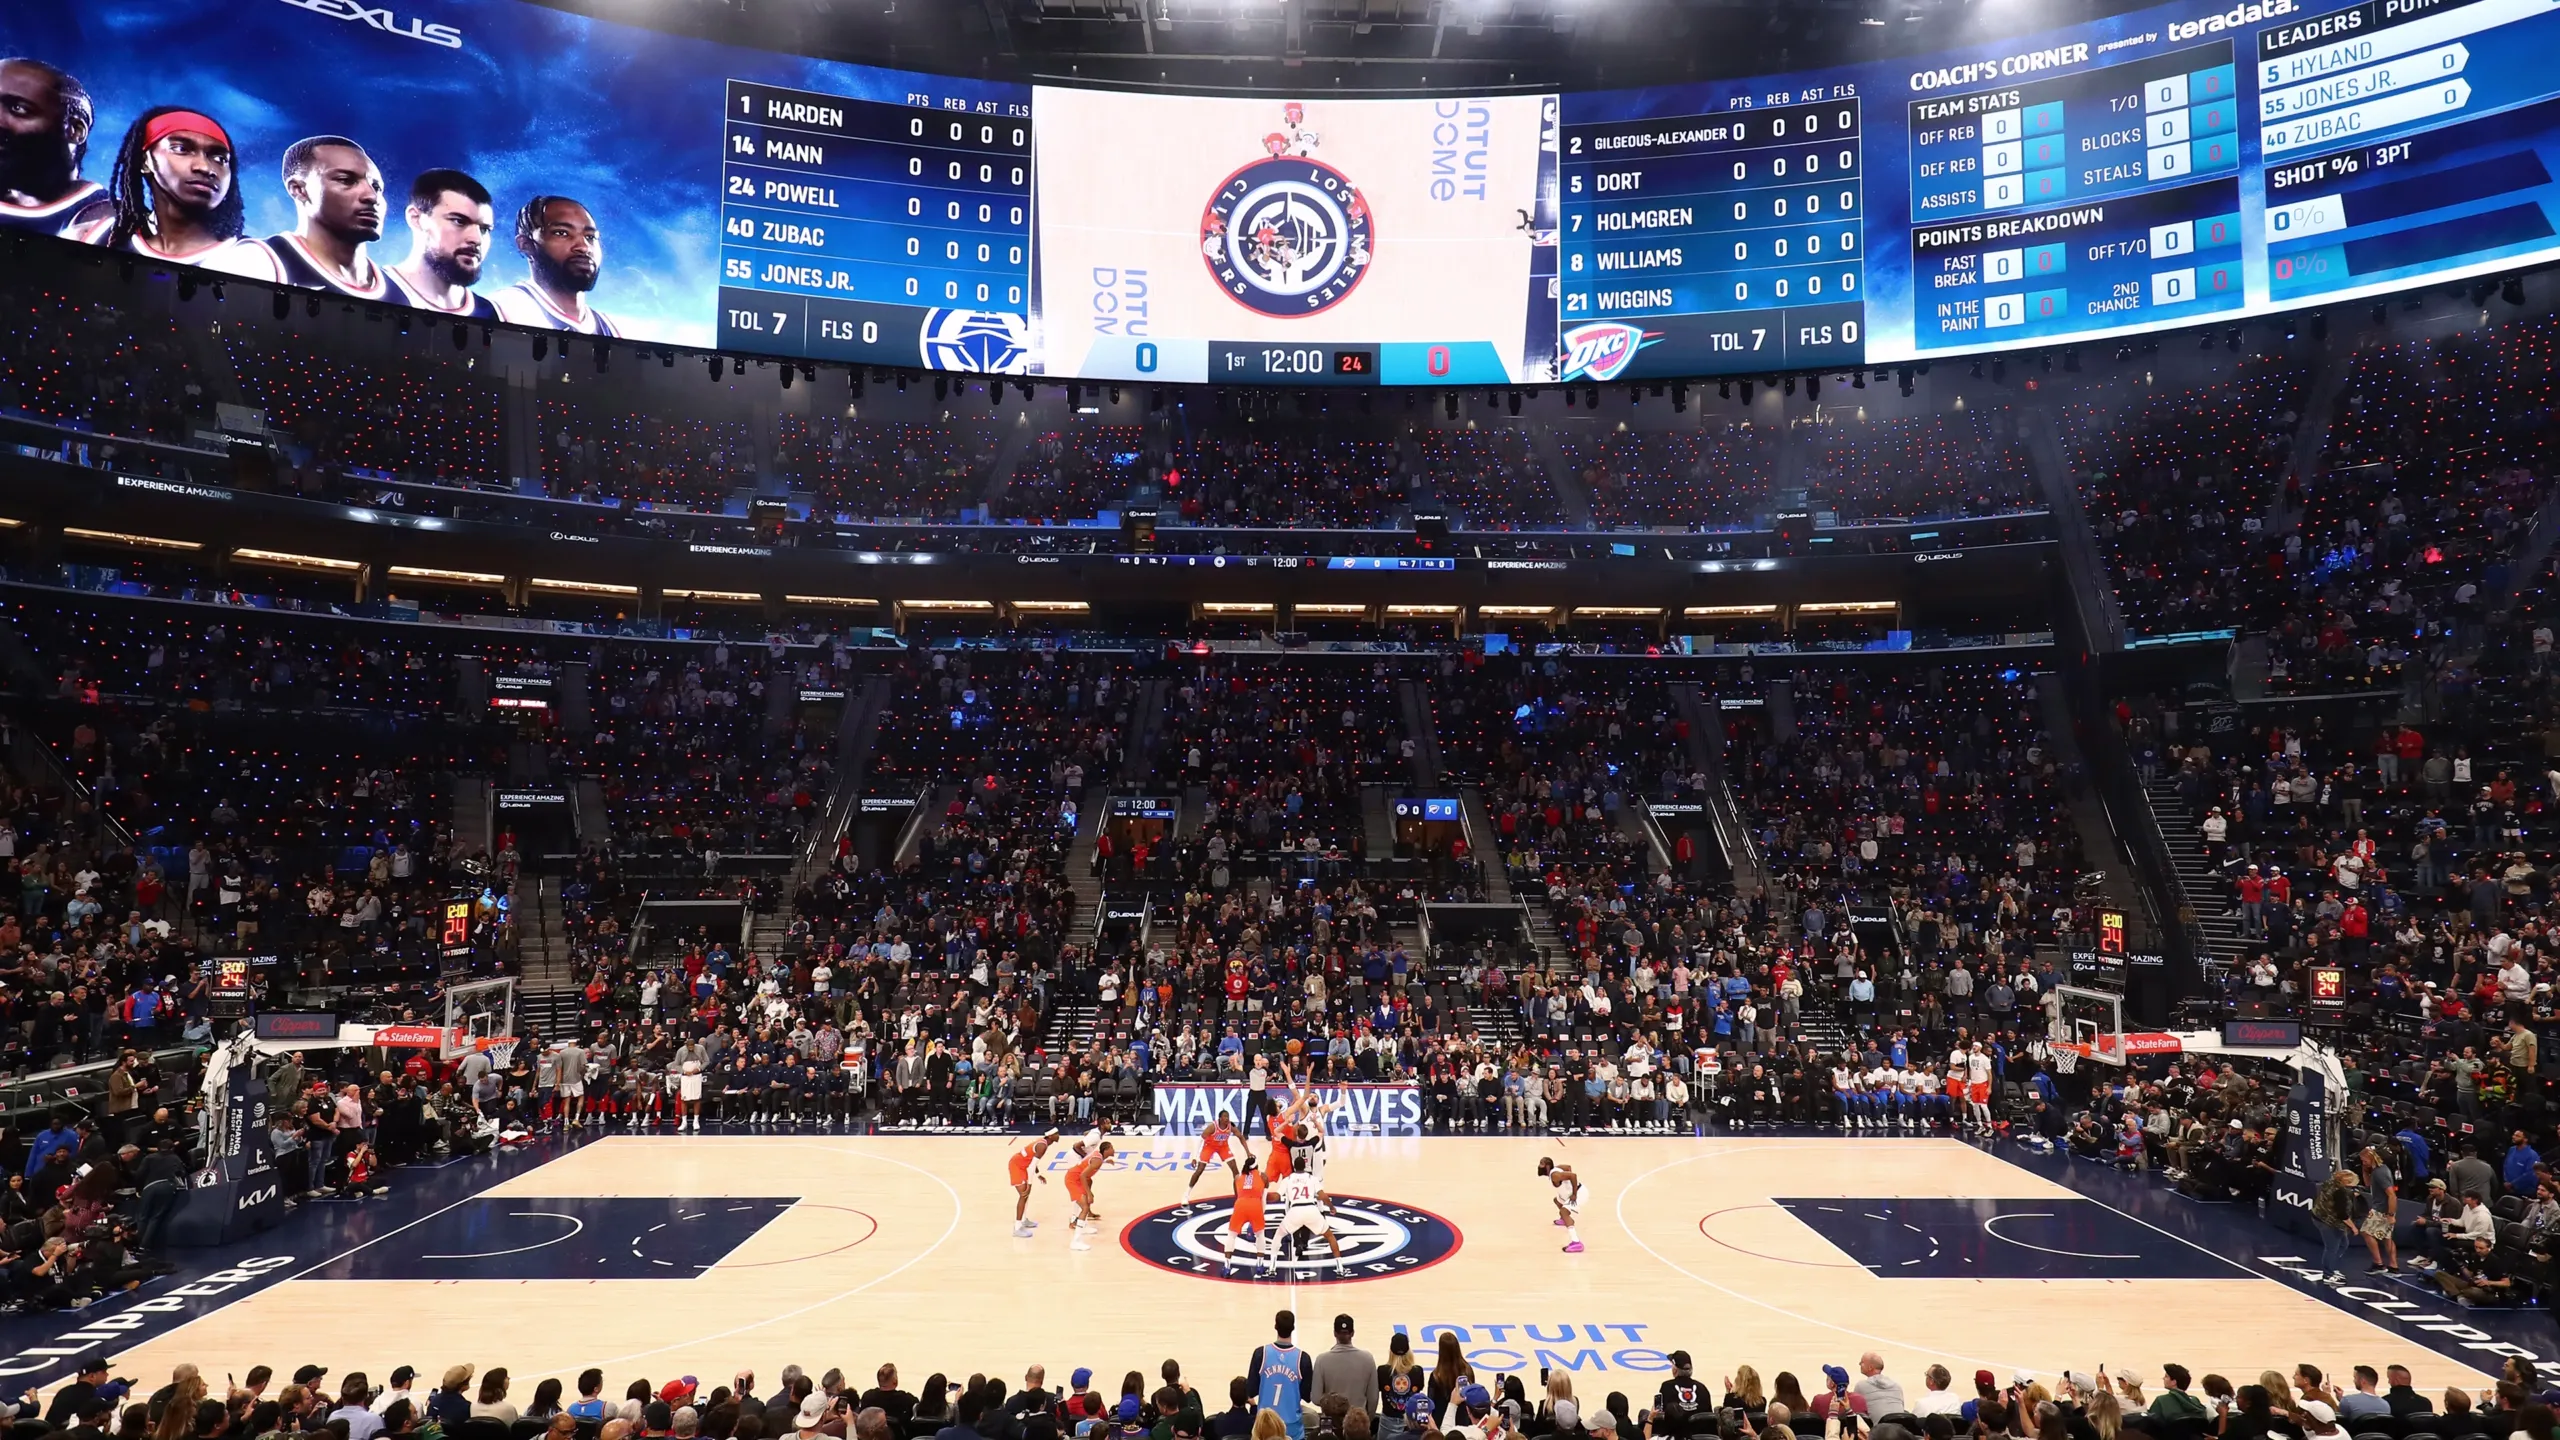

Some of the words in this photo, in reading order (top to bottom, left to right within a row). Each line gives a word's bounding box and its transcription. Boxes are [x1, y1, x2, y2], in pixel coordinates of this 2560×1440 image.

[2266, 10, 2362, 50] LEADERS
[1910, 60, 1997, 91] COACH'S
[2002, 43, 2088, 75] CORNER
[2098, 34, 2144, 54] presented
[2146, 31, 2158, 44] by
[2268, 66, 2279, 83] 5
[2292, 41, 2372, 78] HYLAND
[2265, 100, 2285, 114] 55
[2293, 78, 2359, 110] JONES
[2365, 70, 2396, 92] JR.
[2442, 54, 2454, 70] 0
[908, 93, 930, 107] PTS
[944, 98, 966, 111] REB
[976, 102, 998, 114] AST
[1009, 104, 1029, 117] FLS
[1730, 97, 1752, 110] PTS
[1767, 92, 1790, 106] REB
[1802, 88, 1824, 102] AST
[1834, 84, 1855, 97] FLS
[1918, 99, 1964, 120] TEAM
[1968, 91, 2020, 114] STATS
[2110, 96, 2138, 113] T/O
[741, 96, 750, 113] 1
[768, 100, 843, 128] HARDEN
[2266, 131, 2286, 146] 40
[2294, 112, 2361, 144] ZUBAC
[2444, 88, 2456, 104] 0
[1570, 138, 1582, 154] 2
[1595, 128, 1727, 150] GILGEOUS-ALEXANDER
[1920, 131, 1944, 146] OFF
[1949, 126, 1974, 142] REB
[2082, 128, 2141, 152] BLOCKS
[732, 135, 755, 155] 14
[766, 140, 823, 165] MANN
[1920, 162, 1946, 177] DEF
[1950, 158, 1976, 174] REB
[2084, 162, 2142, 185] STEALS
[2274, 162, 2326, 188] SHOT
[2332, 156, 2358, 174] %
[2376, 142, 2412, 166] 3PT
[728, 176, 756, 196] 24
[765, 181, 839, 208] POWELL
[1570, 176, 1582, 192] 5
[1597, 172, 1642, 192] DORT
[1921, 190, 1976, 208] ASSISTS
[1572, 215, 1582, 232] 7
[1598, 208, 1692, 231] HOLMGREN
[1918, 226, 1982, 247] POINTS
[1986, 208, 2104, 239] BREAKDOWN
[727, 217, 754, 238] 40
[762, 222, 824, 247] ZUBAC
[1571, 254, 1584, 272] 8
[1598, 248, 1682, 270] WILLIAMS
[2088, 244, 2115, 261] OFF
[2120, 239, 2146, 256] T/O
[726, 258, 752, 280] 55
[761, 263, 822, 288] JONES
[826, 271, 854, 291] JR.
[1944, 256, 1976, 272] FAST
[1934, 272, 1976, 288] BREAK
[2113, 282, 2140, 297] 2ND
[1567, 294, 1588, 310] 21
[1598, 289, 1672, 310] WIGGINS
[1938, 304, 1952, 318] IN
[1955, 300, 1979, 315] THE
[2088, 297, 2140, 315] CHANCE
[728, 310, 762, 332] TOL
[772, 312, 787, 334] 7
[822, 320, 853, 340] FLS
[862, 321, 878, 344] 0
[1942, 317, 1979, 332] PAINT
[1711, 334, 1744, 351] TOL
[1752, 329, 1766, 350] 7
[1800, 326, 1832, 346] FLS
[1842, 321, 1858, 343] 0
[1136, 342, 1158, 373] 0
[1226, 351, 1246, 372] 1ST
[1262, 350, 1324, 374] 12:00
[1342, 356, 1363, 372] 24
[1428, 345, 1450, 377] 0
[125, 478, 184, 494] EXPERIENCE
[186, 487, 232, 500] AMAZING
[564, 534, 599, 542] LEXUS
[695, 545, 738, 554] EXPERIENCE
[738, 547, 772, 556] AMAZING
[1928, 552, 1963, 560] LEXUS
[1273, 558, 1298, 568] 12:00
[1132, 800, 1156, 810] 12:00
[1412, 806, 1420, 815] 0
[1444, 806, 1452, 815] 0
[445, 918, 466, 944] 24
[2102, 928, 2122, 952] 24
[450, 948, 470, 956] TISSOT
[2104, 956, 2124, 966] TISSOT
[2130, 956, 2164, 964] MAZING
[221, 974, 240, 987] 24
[2318, 982, 2336, 996] 24
[271, 1016, 320, 1033] Clippers
[2238, 1024, 2286, 1040] Clippers
[1154, 1088, 1259, 1124] MAK
[232, 1108, 244, 1156] PECHANGA
[252, 1118, 266, 1128] AT&T
[2288, 1126, 2302, 1136] AT&T
[2314, 1114, 2323, 1160] PECHANGA
[1298, 1148, 1306, 1158] 14
[1292, 1186, 1310, 1200] 24
[1152, 1202, 1216, 1224] LOS
[0, 1255, 296, 1376] CLIPPERS
[1264, 1364, 1298, 1383] JENNINGS
[1272, 1384, 1283, 1406] 1
